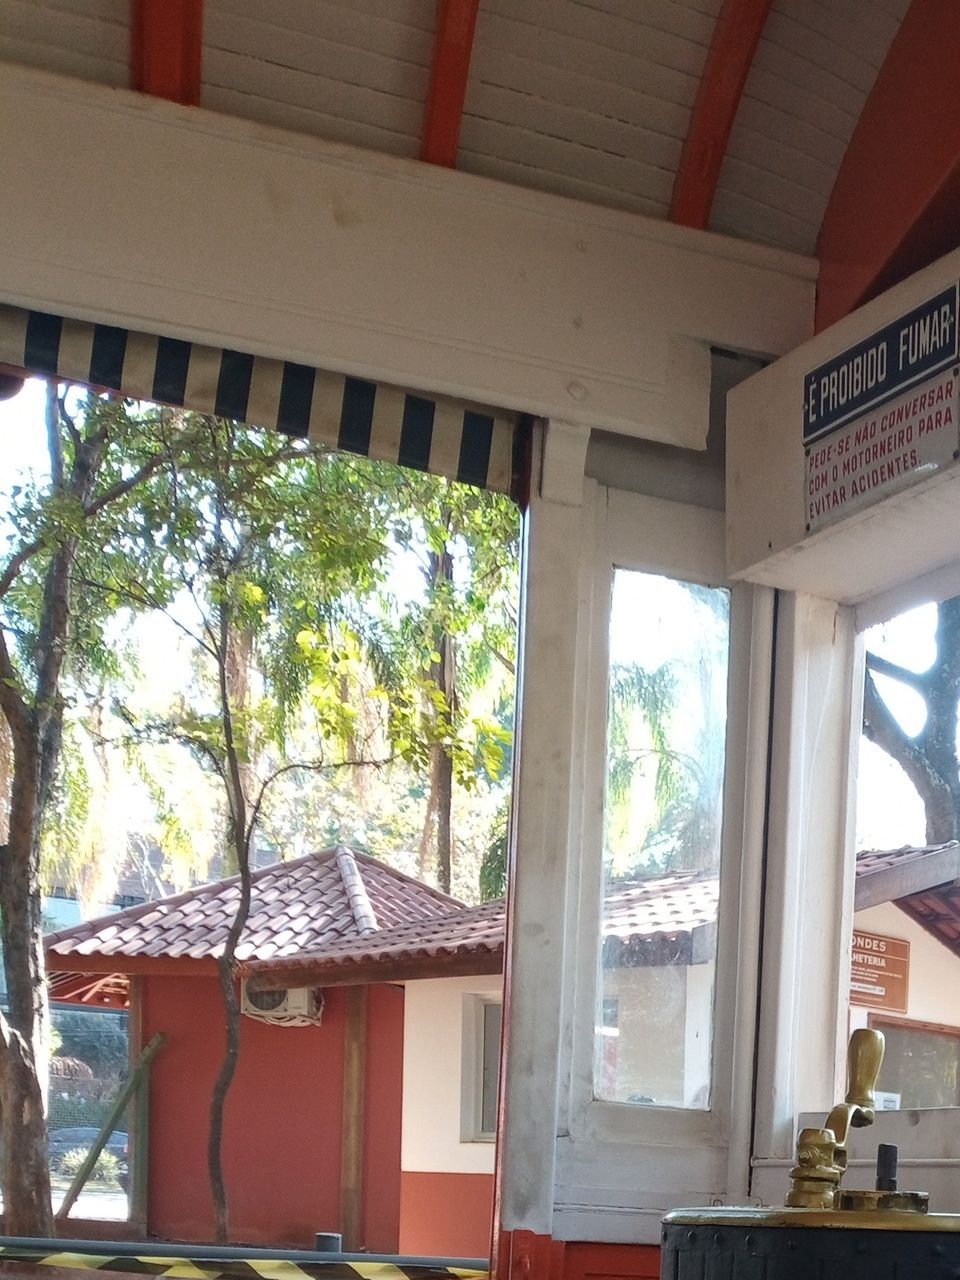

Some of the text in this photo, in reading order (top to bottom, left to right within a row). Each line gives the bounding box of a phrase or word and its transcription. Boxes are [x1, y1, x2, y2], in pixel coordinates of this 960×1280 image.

[809, 303, 951, 424] É PROIBIDO FUMAR
[808, 406, 953, 495] COM O MOTORNEIRO PARA
[809, 381, 953, 473] PEDE-SE NÃO CONVERSAR
[809, 449, 921, 519] EVITAR ACIDENTES.
[852, 952, 886, 968] HETERIA
